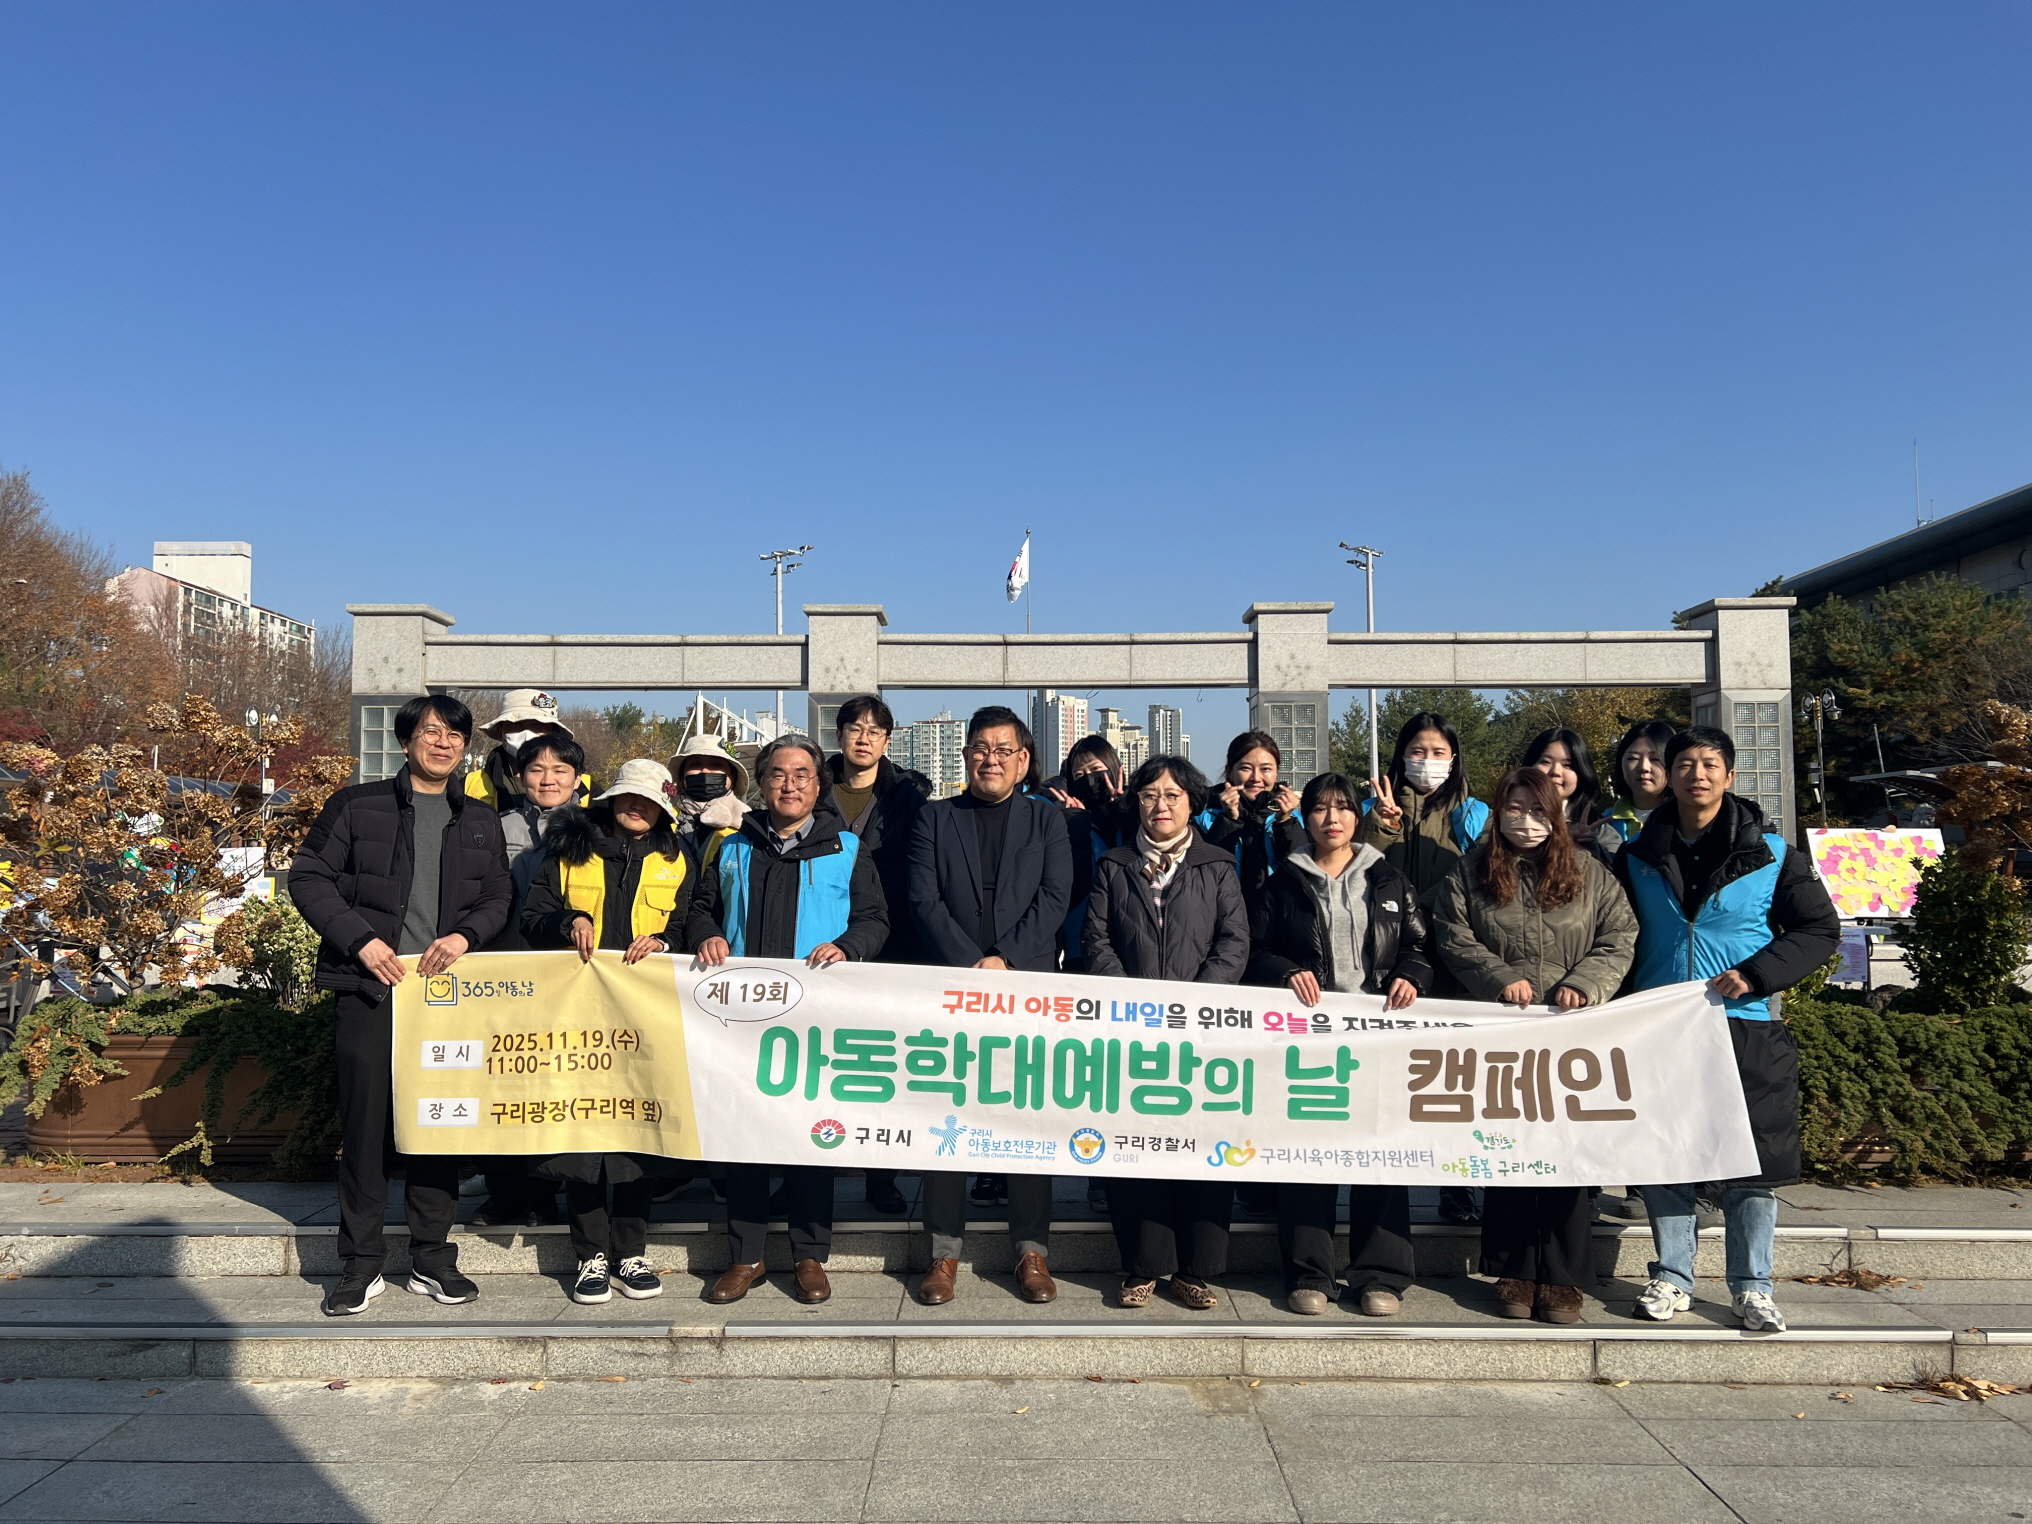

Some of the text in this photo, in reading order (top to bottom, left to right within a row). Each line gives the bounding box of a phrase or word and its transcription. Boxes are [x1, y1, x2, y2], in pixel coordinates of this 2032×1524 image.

[706, 980, 788, 1005] 제 19회
[942, 990, 1015, 1014] 구리시
[1024, 996, 1101, 1022] 아동의
[1111, 1000, 1187, 1029] 내일을
[1198, 1006, 1253, 1030] 위해
[1263, 1010, 1332, 1034] 오늘을
[491, 1028, 640, 1053] 2025.11.19.(수)
[486, 1052, 613, 1075] 11:00~15:00
[756, 1025, 1636, 1123] 아동학대예방의 날 캠페인
[855, 1127, 912, 1147] 구리시
[969, 1128, 993, 1138] 구리시
[1485, 1136, 1510, 1146] 경기도
[968, 1138, 1057, 1155] 아동보호전문기관
[1114, 1135, 1196, 1153] 구리경찰서
[1113, 1153, 1139, 1163] GURI
[1260, 1147, 1435, 1168] 구리시육아종합지원센터
[1442, 1155, 1492, 1179] 아동돌봄
